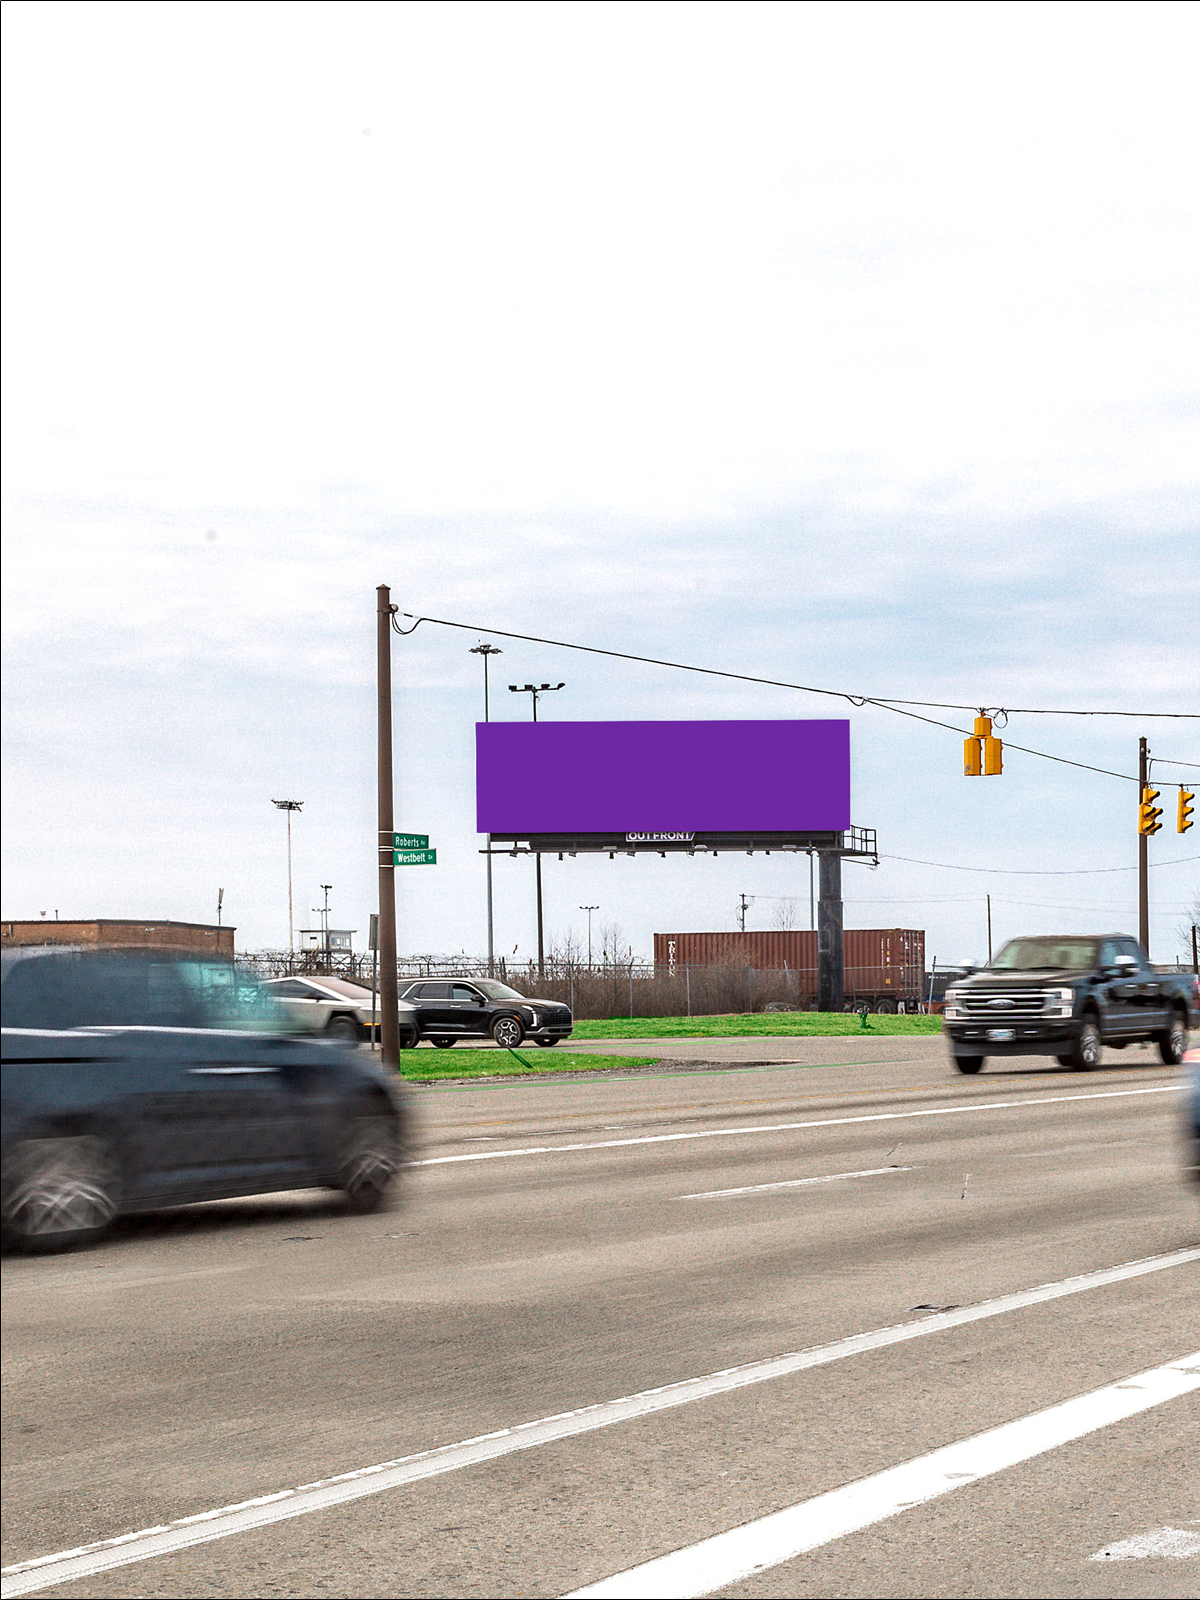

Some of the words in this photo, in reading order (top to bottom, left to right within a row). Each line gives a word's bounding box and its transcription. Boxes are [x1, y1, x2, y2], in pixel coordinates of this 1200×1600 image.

[628, 832, 690, 840] OUTFRONT
[395, 836, 420, 847] Roberts
[397, 853, 426, 863] Westbelt
[668, 941, 676, 977] TRITON
